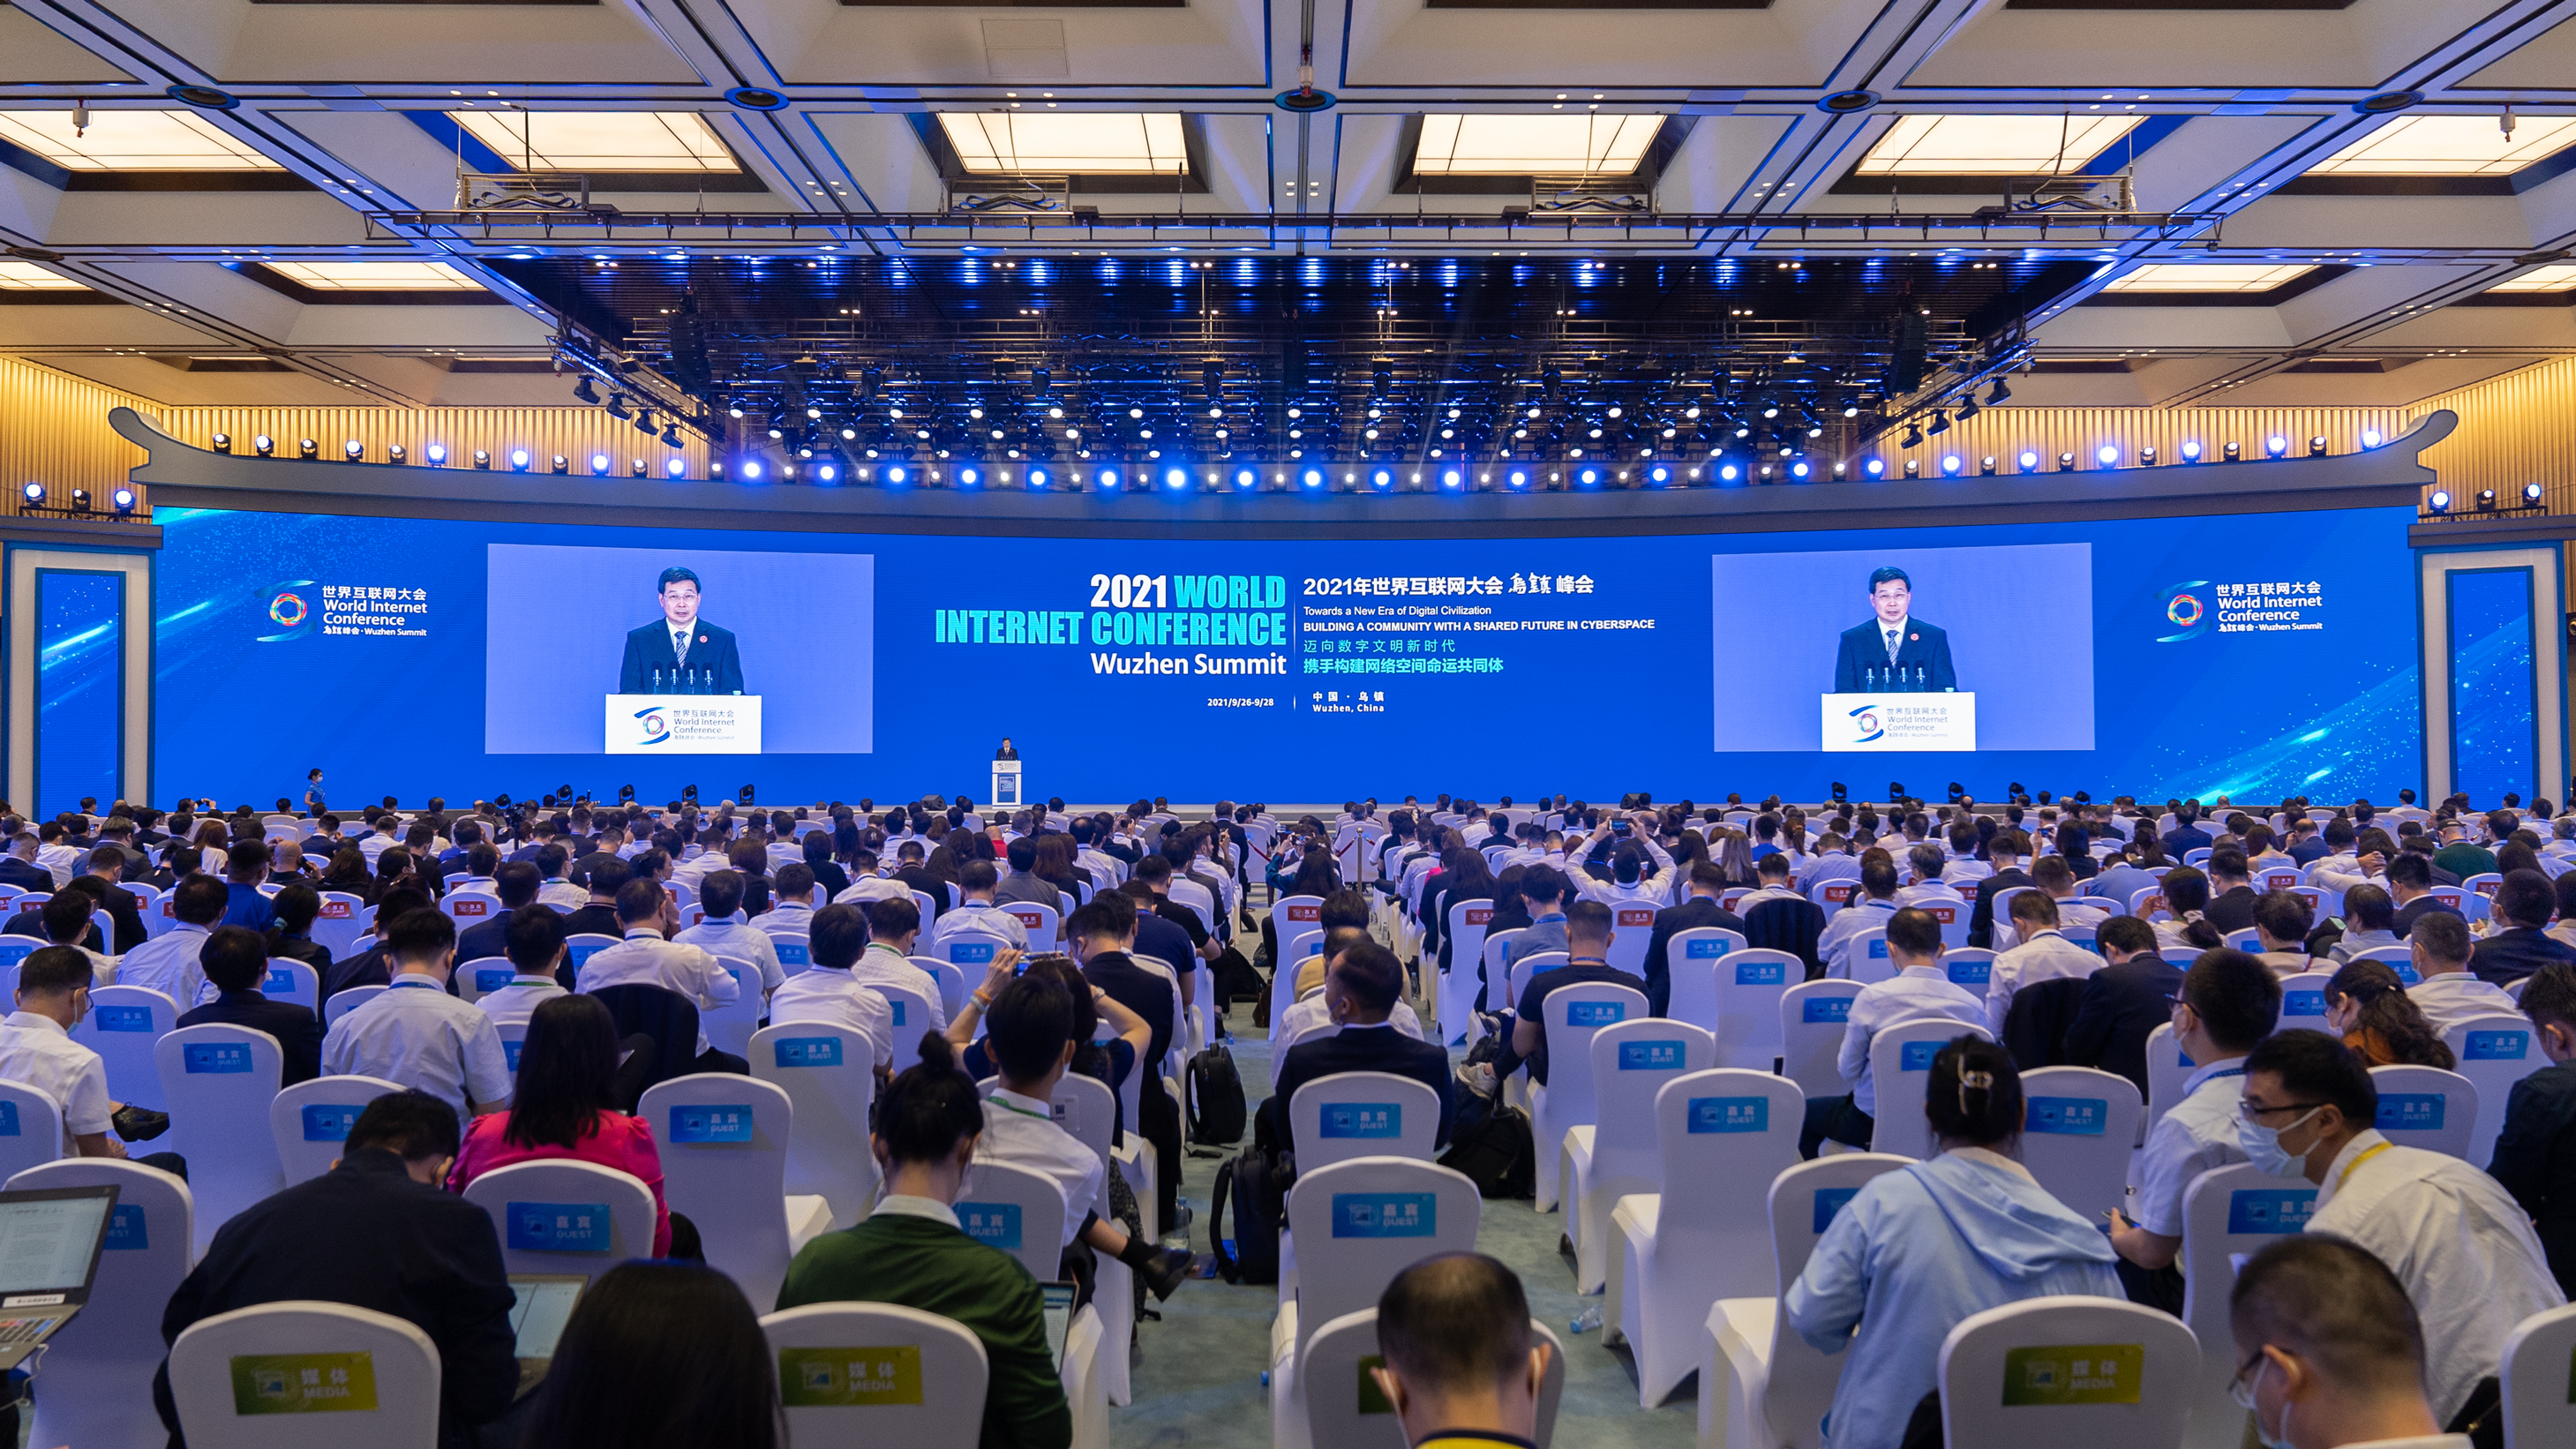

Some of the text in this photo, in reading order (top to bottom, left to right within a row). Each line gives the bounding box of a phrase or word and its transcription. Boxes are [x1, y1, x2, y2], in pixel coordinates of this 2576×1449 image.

[322, 586, 426, 601] 世界互联网大会
[1091, 574, 1285, 608] 2021 WORLD
[2216, 581, 2321, 597] 世界互联网大会
[324, 599, 427, 612] World Internet
[2218, 596, 2322, 609] World Internet
[1303, 606, 1342, 615] Towards
[1355, 606, 1375, 615] New
[1378, 606, 1394, 615] Era
[1397, 606, 1407, 615] of
[1409, 606, 1438, 617] Digital
[1441, 606, 1491, 615] Civilization
[2219, 610, 2300, 621] Conference
[324, 612, 405, 626] Conference
[1304, 622, 1354, 631] BUILDING
[1357, 622, 1364, 631] A
[1367, 622, 1431, 631] COMMUNITY
[1434, 622, 1461, 631] WITH
[1474, 621, 1518, 630] SHARED
[1521, 621, 1564, 630] FUTURE
[1581, 619, 1655, 629] CYBERSPACE
[936, 610, 1286, 645] INTERNET CONFERENCE
[1304, 639, 1455, 652] 迈向数字文明新时代
[1091, 652, 1287, 674] Wuzhen Summit
[1304, 657, 1503, 673] 携手构建网络空间命运共同体
[1208, 698, 1273, 707] 2021/9/26-9/28
[1727, 1105, 1754, 1116] 嘉宾
[2066, 1106, 2093, 1118] 嘉宾
[2404, 1102, 2430, 1113] 嘉宾
[710, 1113, 739, 1124] 嘉宾
[1360, 1111, 1387, 1122] 嘉宾
[710, 1123, 740, 1132] GUEST
[1360, 1121, 1387, 1130] GUEST
[1383, 1203, 1418, 1217] 嘉宾
[556, 1215, 590, 1228] 嘉宾
[969, 1213, 1003, 1227] 嘉宾
[1383, 1216, 1419, 1227] GUEST
[557, 1229, 592, 1238] GUEST
[969, 1228, 1005, 1236] GUEST
[848, 1361, 896, 1378] 媒体
[2070, 1359, 2117, 1377] 媒体
[300, 1368, 349, 1385] 媒体
[848, 1378, 896, 1392] MEDIA
[2069, 1378, 2114, 1390] MEDIA
[303, 1385, 350, 1399] MEDIA
